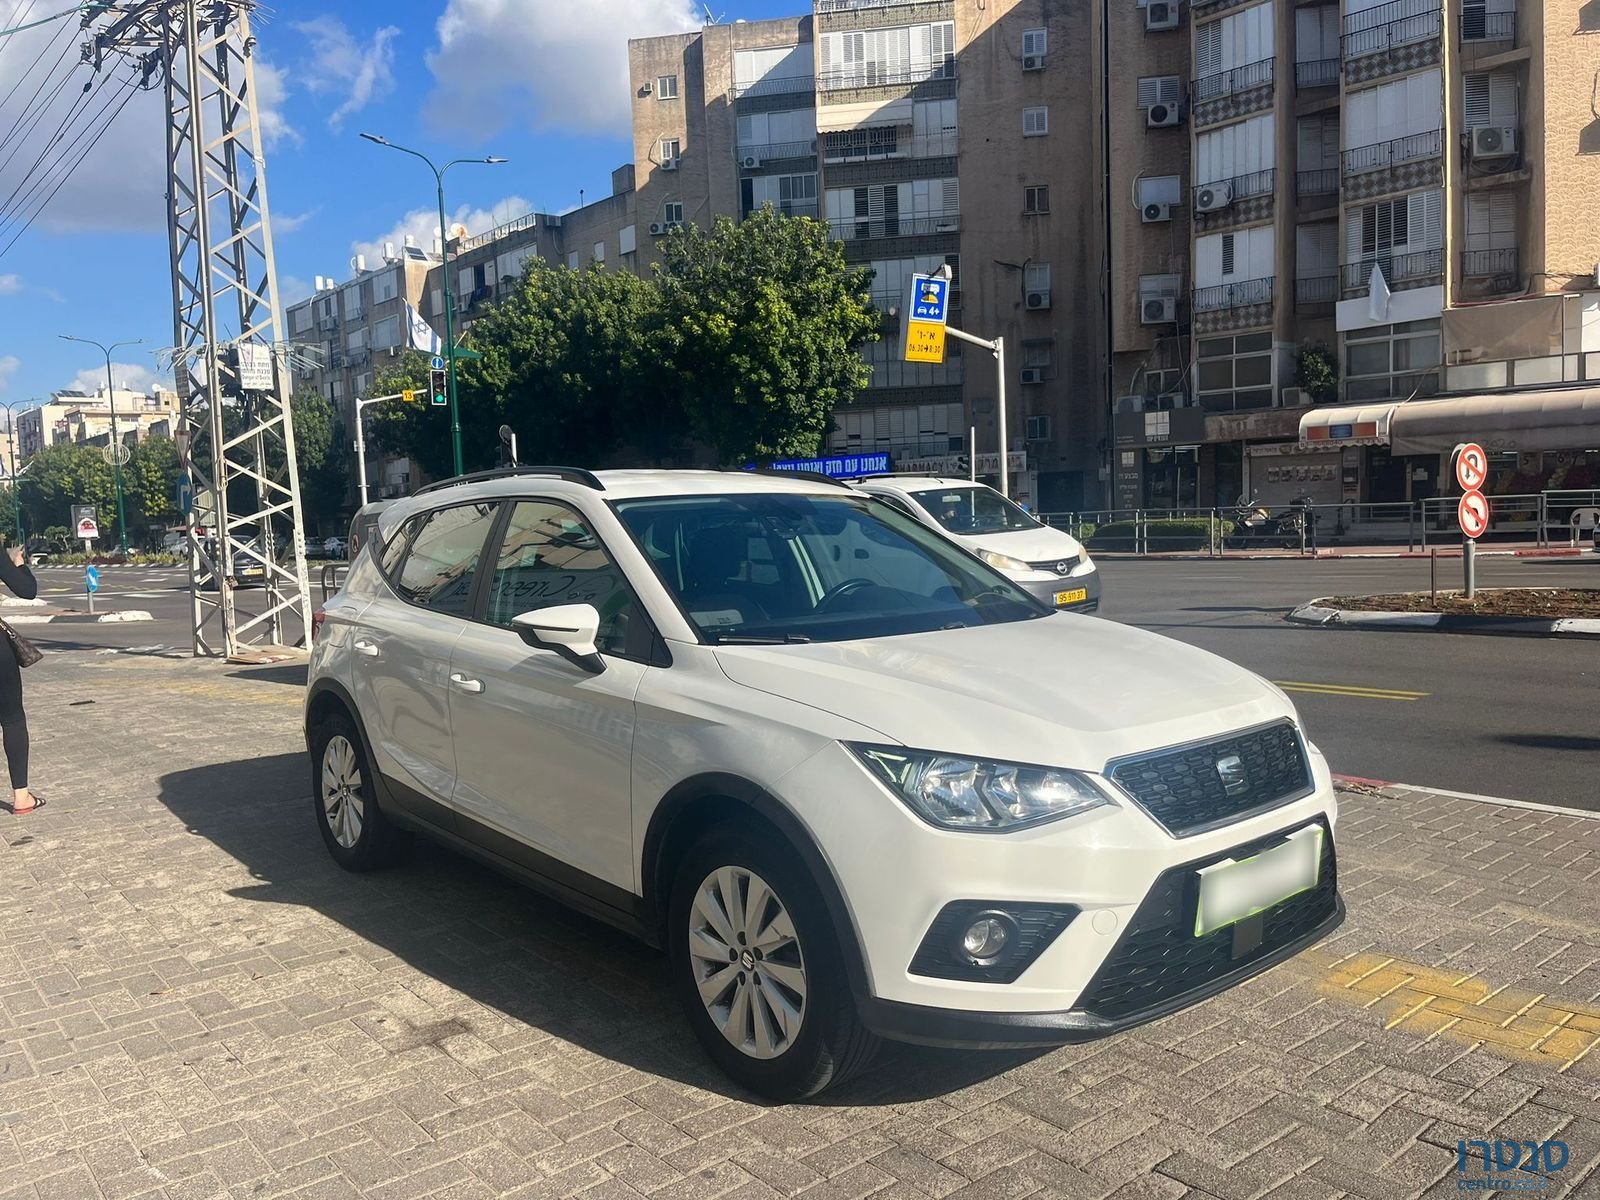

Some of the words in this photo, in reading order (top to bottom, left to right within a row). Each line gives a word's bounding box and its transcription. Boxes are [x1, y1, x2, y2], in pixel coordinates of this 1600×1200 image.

[929, 306, 940, 316] 4+
[404, 391, 413, 399] 13
[825, 460, 842, 475] חזק
[845, 458, 858, 473] עם
[861, 456, 887, 472] אנחנו
[895, 461, 944, 473] PHARMACY
